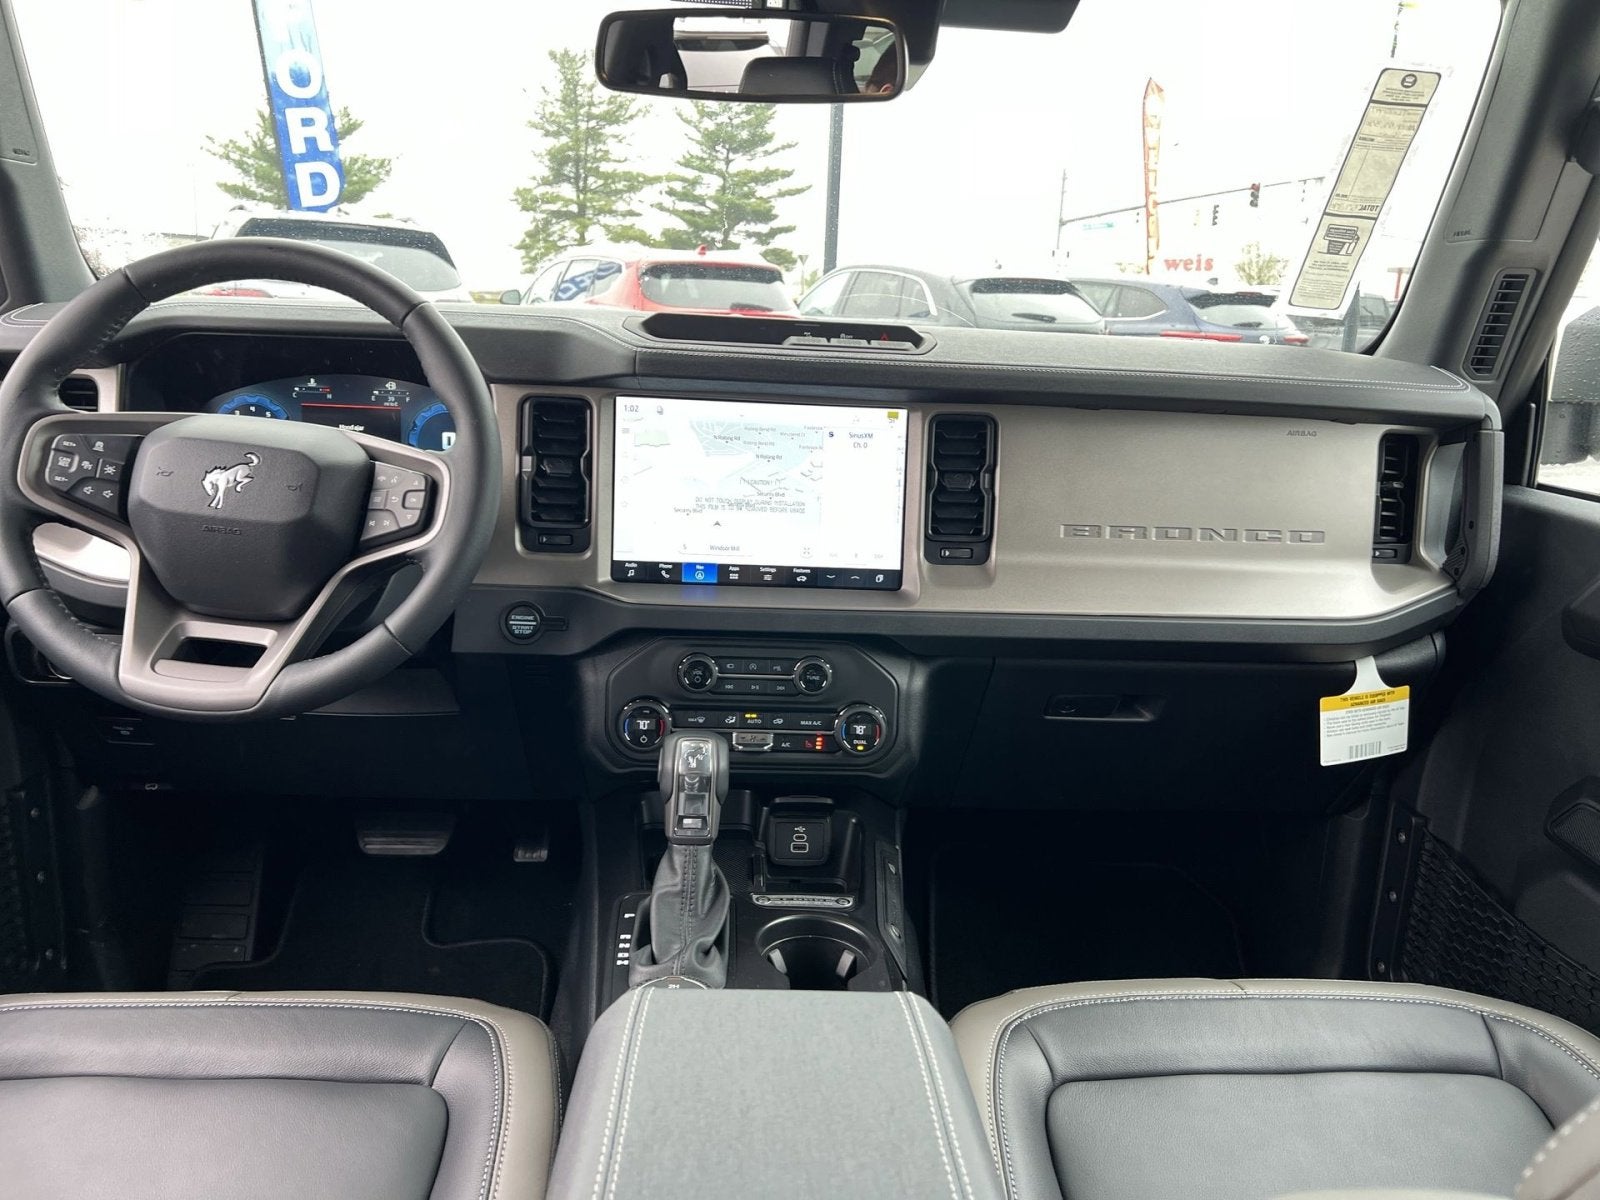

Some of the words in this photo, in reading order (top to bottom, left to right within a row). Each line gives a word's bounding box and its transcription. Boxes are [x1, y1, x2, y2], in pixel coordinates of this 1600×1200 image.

[265, 0, 341, 209] ORD
[1164, 254, 1214, 272] weis
[624, 404, 640, 413] 1:02
[1286, 430, 1318, 438] AIRBAG
[1059, 523, 1326, 545] BRONCO
